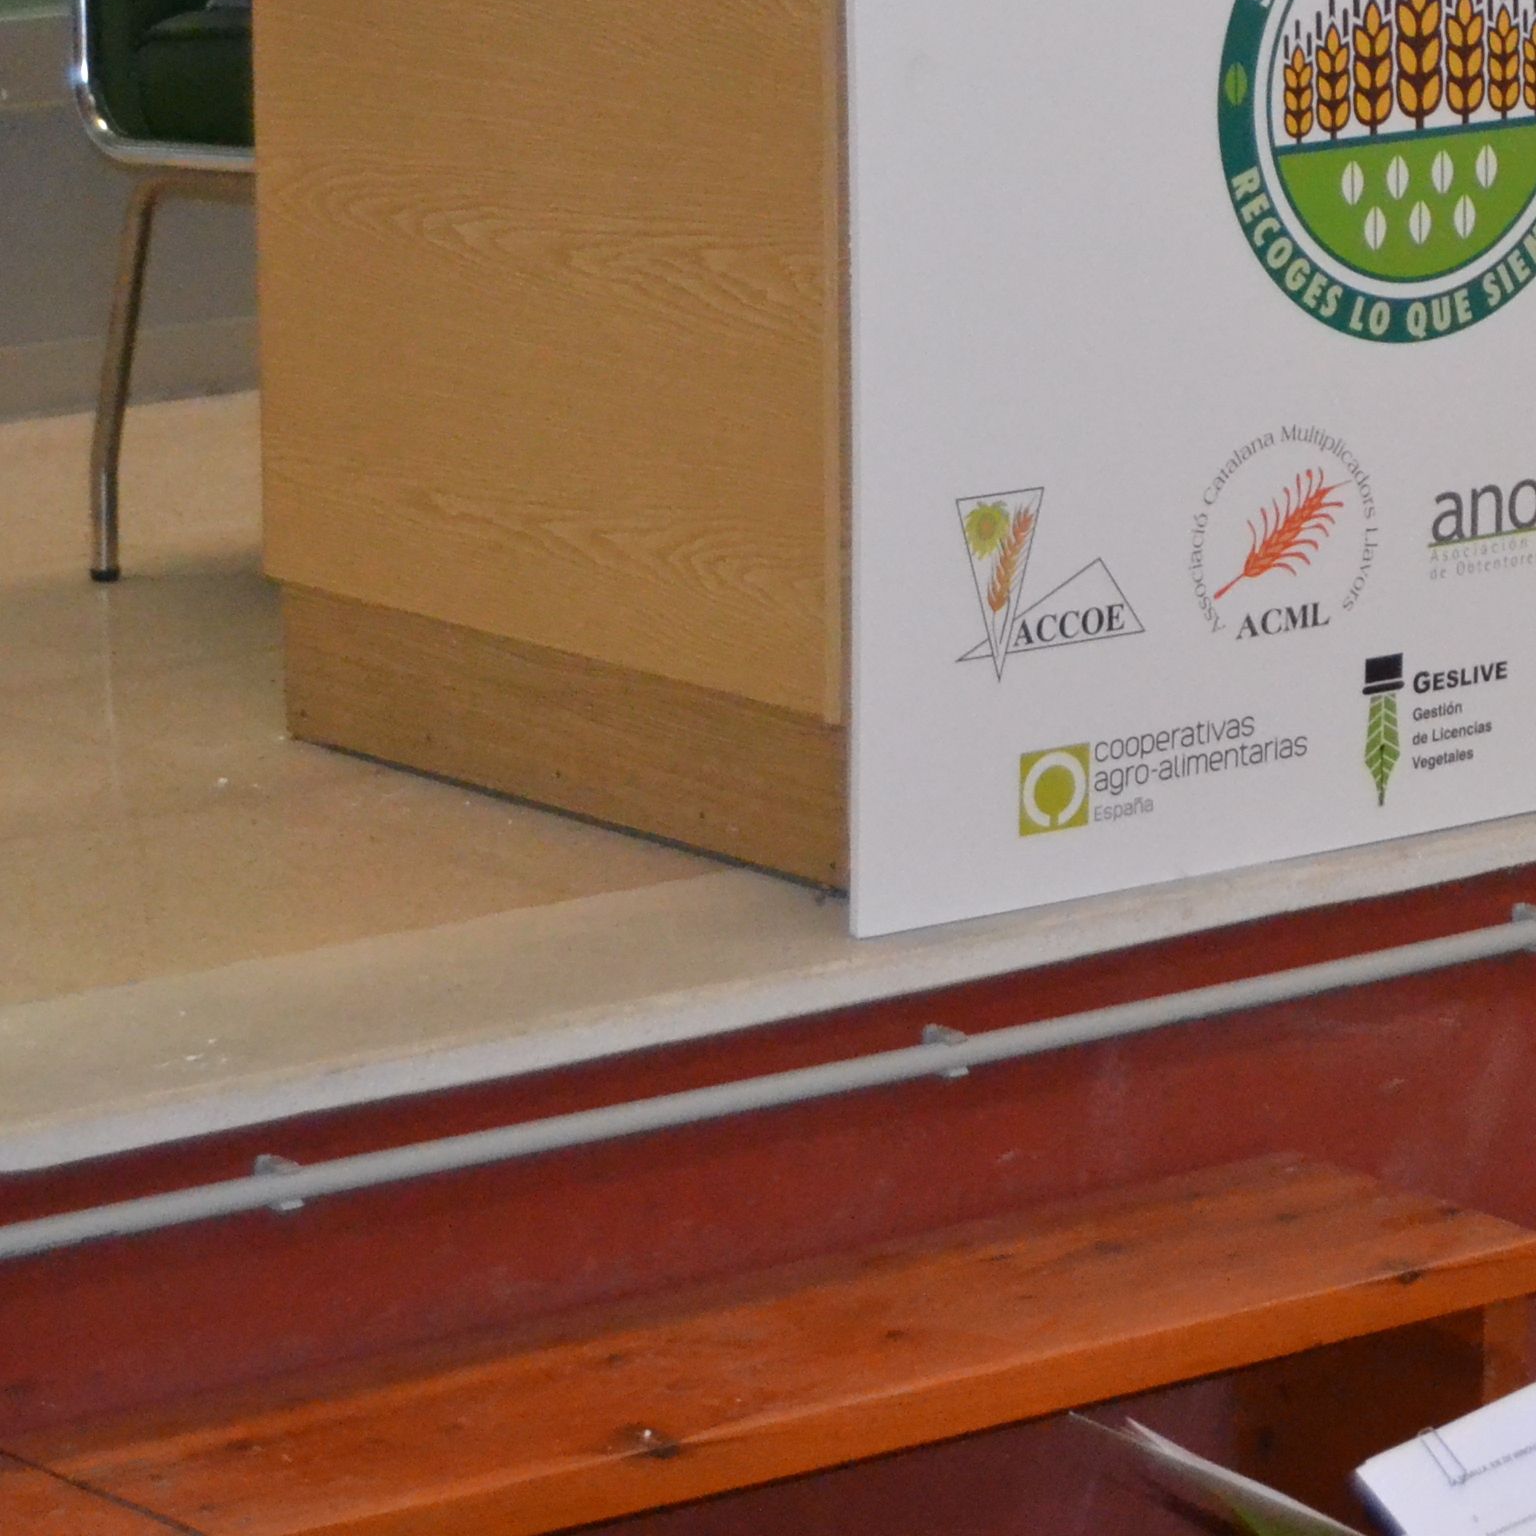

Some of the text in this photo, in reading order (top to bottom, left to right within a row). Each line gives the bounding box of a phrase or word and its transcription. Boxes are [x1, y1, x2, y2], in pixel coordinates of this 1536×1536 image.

[1232, 166, 1343, 319] RECOGES
[1350, 295, 1390, 335] LO
[1406, 294, 1473, 338] QUE
[1203, 432, 1275, 506] Catalana
[1430, 537, 1529, 563] Asociación
[1430, 564, 1447, 580] de
[1014, 603, 1126, 648] ACCOE
[1236, 601, 1331, 640] ACML
[1412, 700, 1463, 722] Gestión
[1094, 715, 1256, 763] cooperativas
[1412, 720, 1492, 746] de Licencias
[1094, 735, 1308, 796] agro-alimentarias
[1412, 748, 1474, 770] Vegetales
[1094, 796, 1154, 822] España
